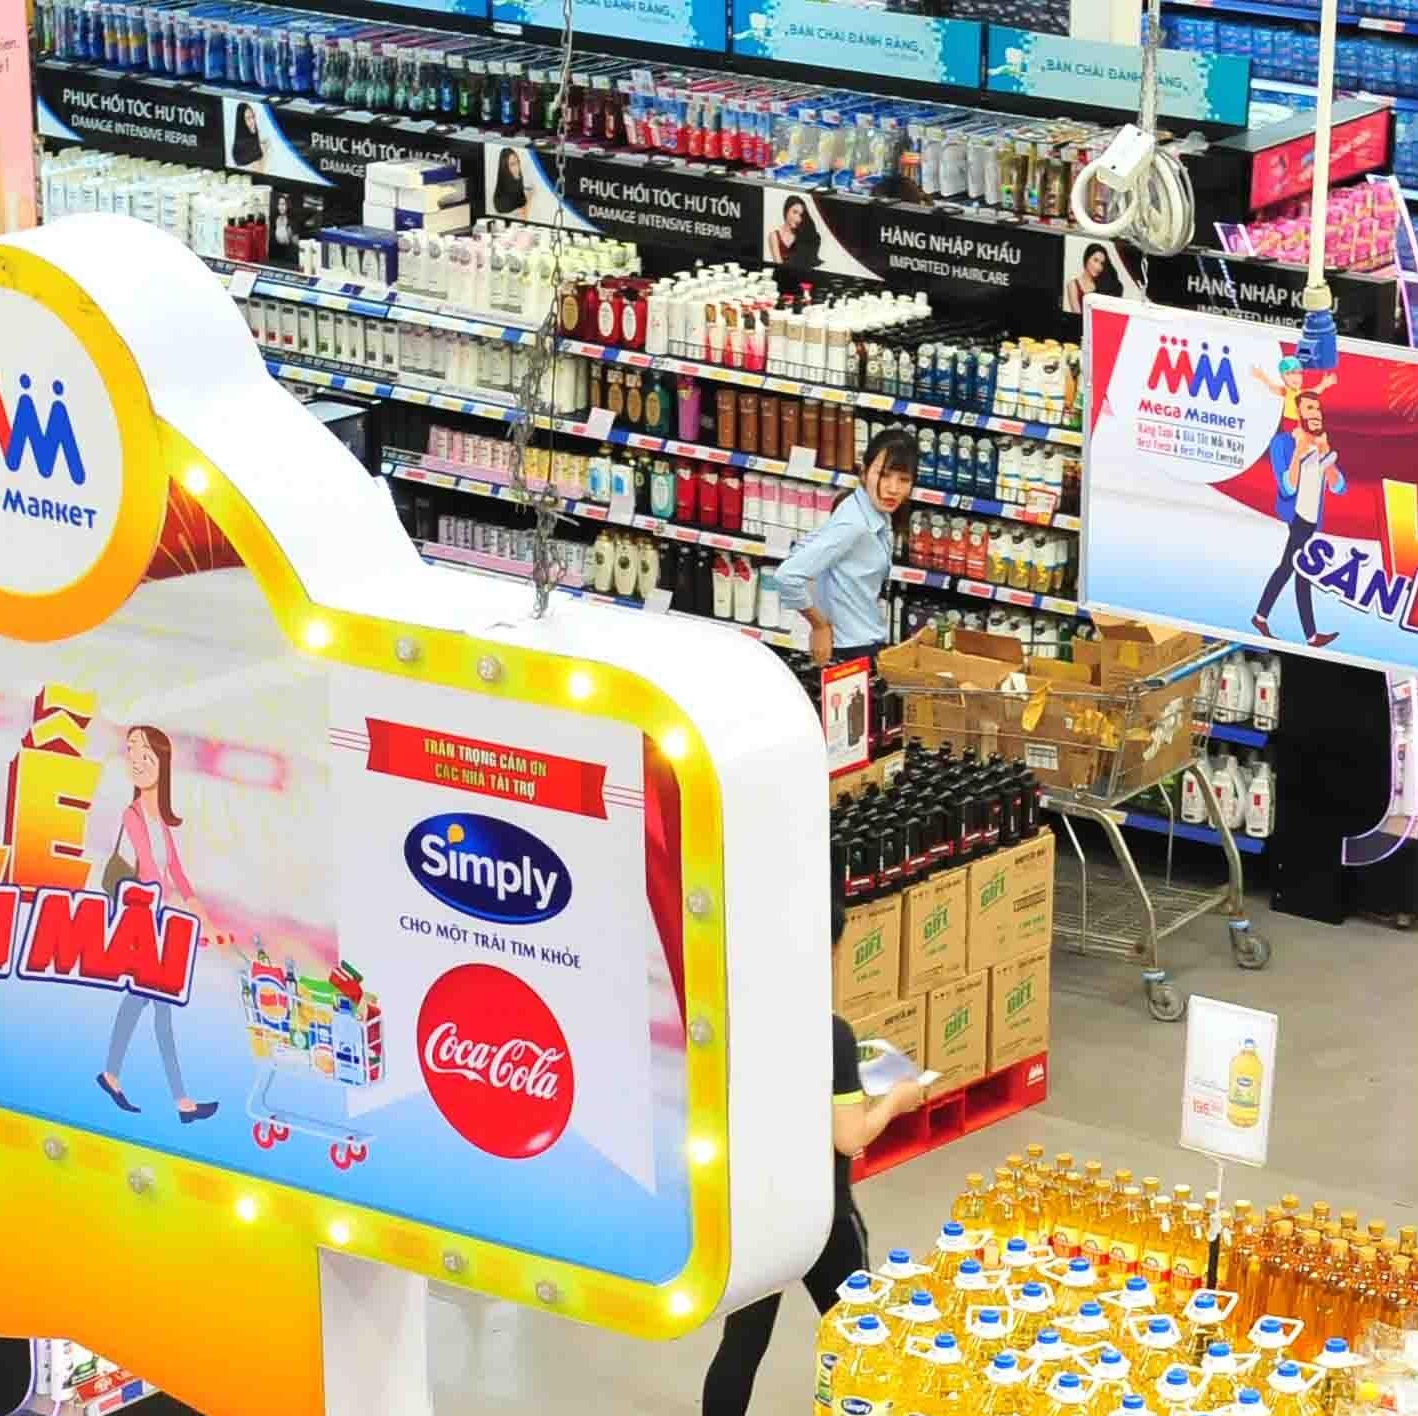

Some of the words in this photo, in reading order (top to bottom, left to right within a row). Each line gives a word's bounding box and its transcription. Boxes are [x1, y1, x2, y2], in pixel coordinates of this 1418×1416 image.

[62, 88, 98, 113] PHỤC
[100, 94, 126, 115] HỒI
[126, 95, 152, 120] TÓC
[153, 101, 176, 123] HƯ
[176, 103, 205, 128] TỔN
[70, 114, 112, 134] DAMAGE
[114, 120, 164, 144] INTENSIVE
[165, 129, 197, 147] REPAIR
[579, 177, 622, 205] PHỤC
[622, 182, 651, 205] HỒI
[651, 185, 682, 211] TÓC
[684, 192, 710, 214] HƯ
[710, 193, 741, 219] TỔN
[588, 204, 635, 224] DAMAGE
[637, 211, 692, 236] INTENSIVE
[694, 221, 732, 240] REPAIR
[880, 223, 925, 251] HÀNG
[928, 230, 973, 262] NHẬP
[976, 236, 1022, 266] KHẨU
[889, 253, 950, 278] IMPORTED
[951, 264, 1010, 288] HAIRCARE
[1187, 273, 1237, 299] HÀNG
[1240, 282, 1288, 309] NHẬP
[1, 487, 98, 532] Market
[1299, 539, 1409, 618] SĂN
[423, 736, 455, 757] TRÂN
[458, 744, 497, 768] TRỌNG
[499, 750, 527, 772] CẢM
[489, 772, 511, 792] TÀI
[513, 779, 537, 801] TRỢ
[420, 823, 558, 910] Simply
[21, 880, 199, 1003] MÃI
[399, 914, 432, 935] CHO
[436, 921, 468, 945] MỘT
[473, 928, 506, 953] TRÁI
[510, 940, 537, 959] TIM
[541, 944, 582, 970] KHỎE
[424, 1021, 567, 1101] Coca-Cola
